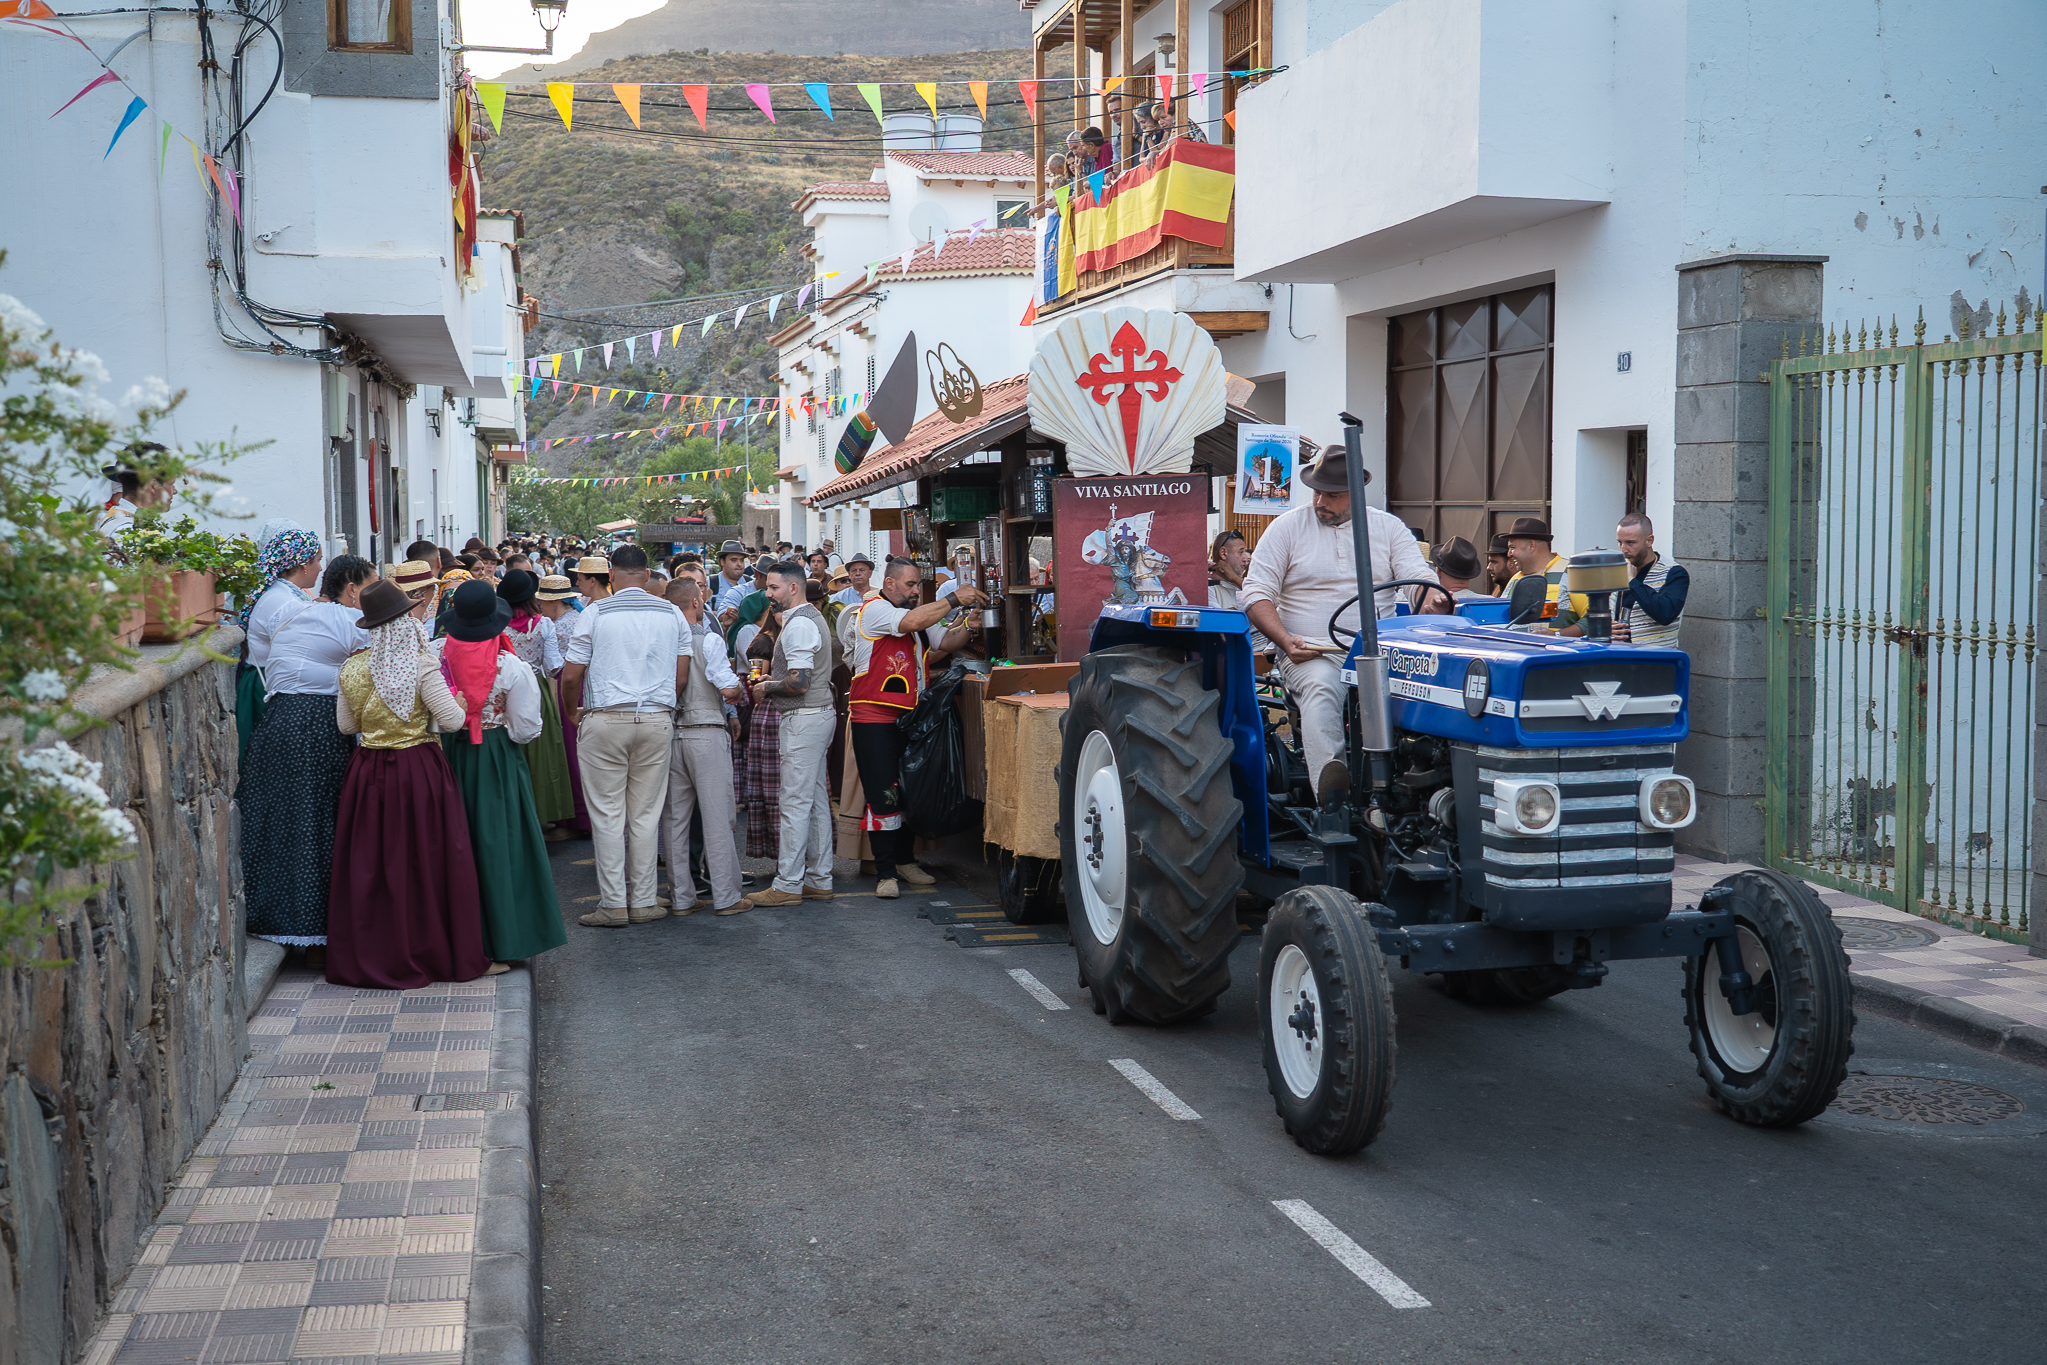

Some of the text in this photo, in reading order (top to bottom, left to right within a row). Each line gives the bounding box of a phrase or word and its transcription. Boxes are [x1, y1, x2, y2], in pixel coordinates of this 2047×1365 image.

[1260, 456, 1274, 484] 1
[1074, 482, 1191, 498] VIVA SANTIAGO
[1391, 648, 1430, 679] Carpeta
[1401, 682, 1431, 699] FERGUSON
[1465, 675, 1487, 699] 165
